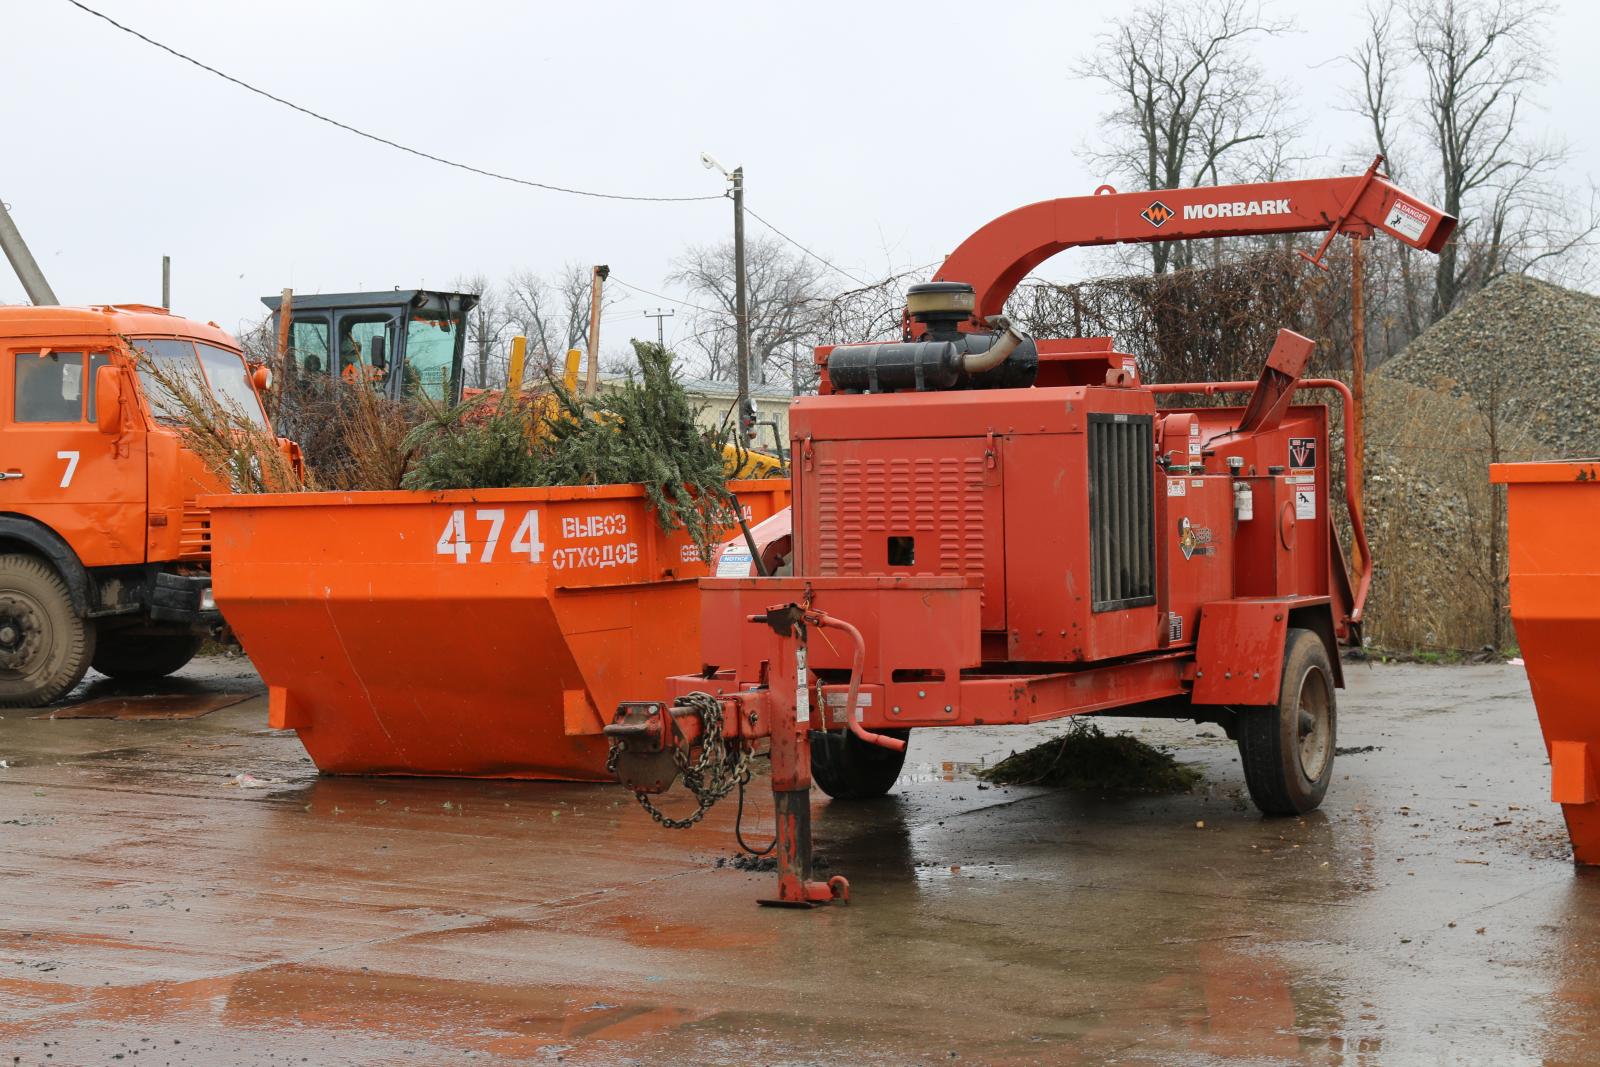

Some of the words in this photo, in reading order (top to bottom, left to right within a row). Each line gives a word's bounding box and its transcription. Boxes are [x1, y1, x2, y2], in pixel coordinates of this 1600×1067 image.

[1183, 200, 1291, 220] MORBARK
[1401, 204, 1428, 223] DANGER
[57, 451, 80, 488] 7
[437, 509, 545, 563] 474
[562, 514, 627, 538] ВЫВОЗ
[552, 543, 638, 570] ОТХОДОВ
